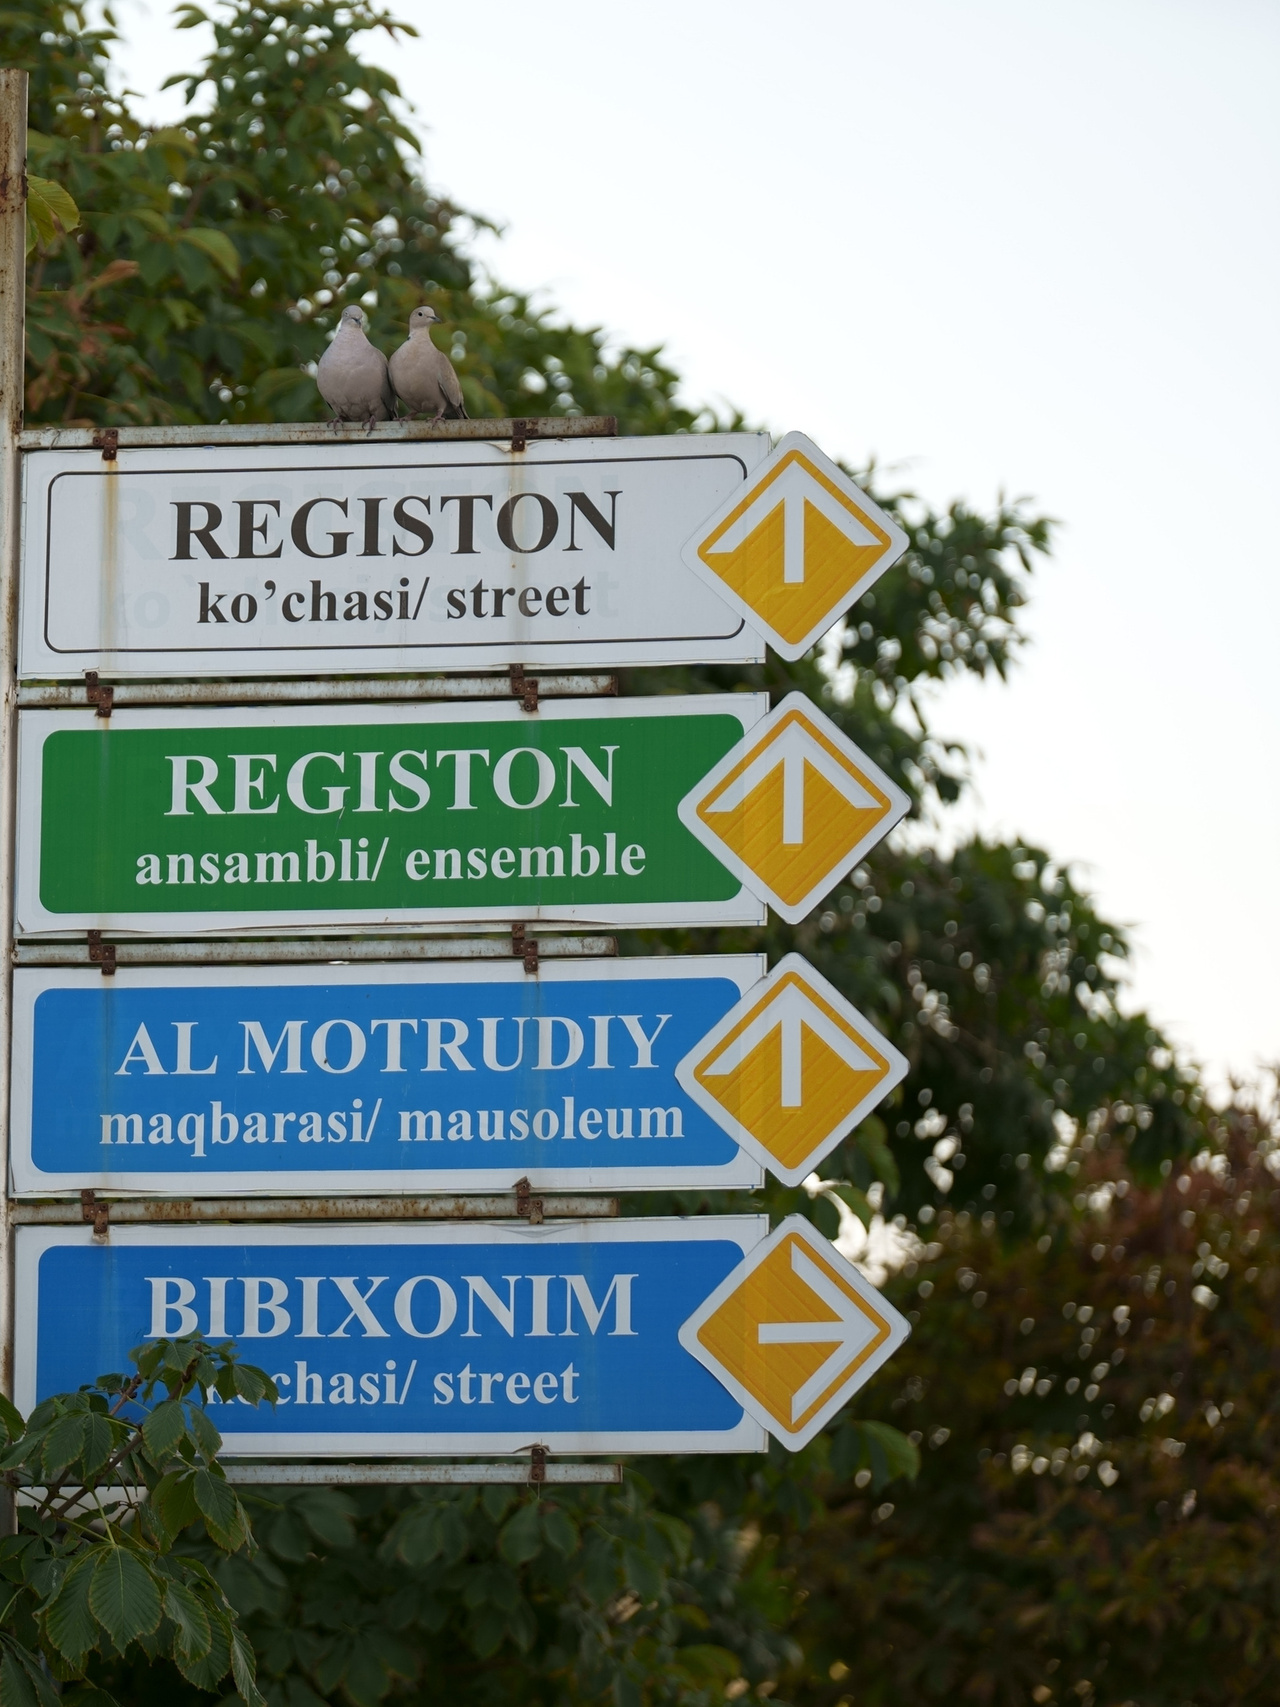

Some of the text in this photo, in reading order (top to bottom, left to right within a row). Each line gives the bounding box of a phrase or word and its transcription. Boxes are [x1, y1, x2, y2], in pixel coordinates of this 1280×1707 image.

[169, 491, 622, 560] REGISTON
[447, 577, 591, 619] street
[164, 746, 619, 815] REGISTON
[136, 833, 645, 884] ansambli/ ensemble
[115, 1013, 673, 1076] AL MOTRUDIY
[100, 1096, 686, 1156] maqbarasi/ mausoleum
[144, 1274, 638, 1338] BIBIXONIM
[434, 1363, 579, 1404] street
